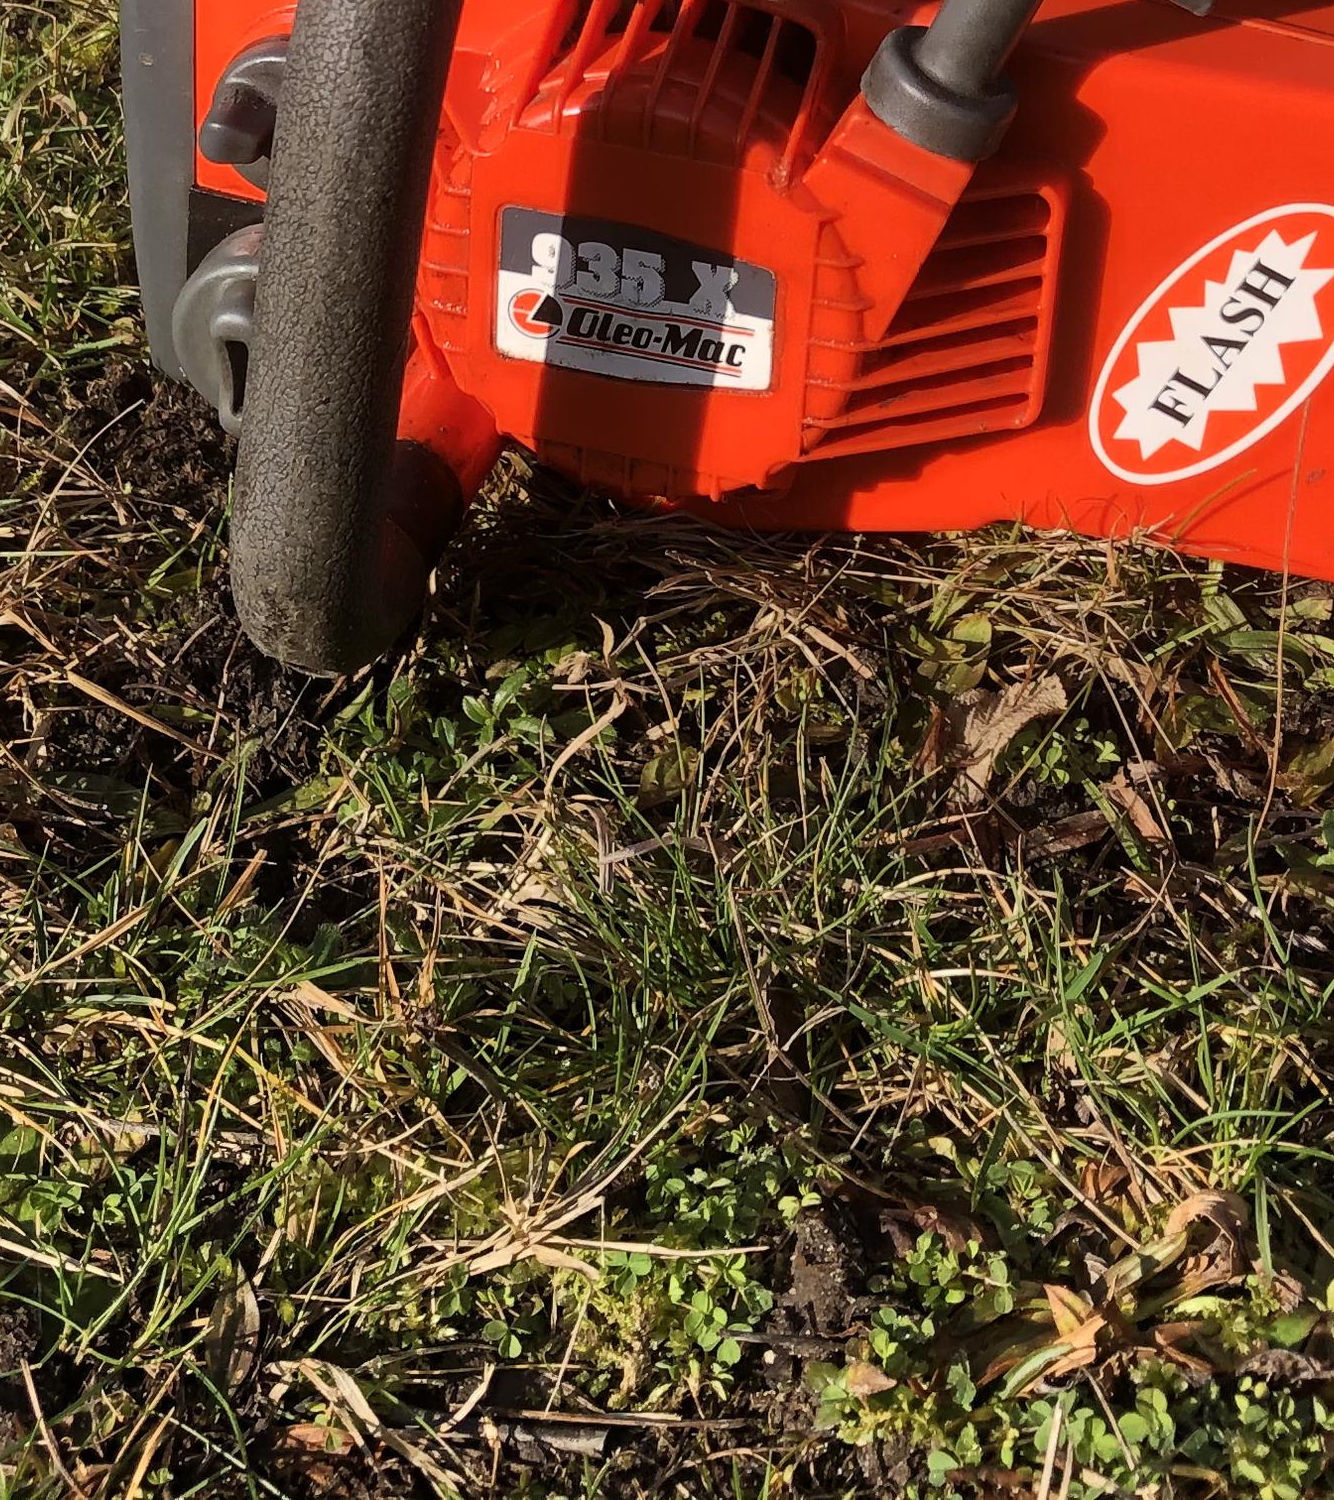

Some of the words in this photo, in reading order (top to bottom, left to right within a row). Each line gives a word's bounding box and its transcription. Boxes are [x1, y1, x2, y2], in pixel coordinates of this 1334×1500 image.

[531, 233, 666, 308] 935
[690, 261, 740, 320] X
[567, 308, 746, 367] Oleo-Mac
[1147, 258, 1296, 429] FLASH
